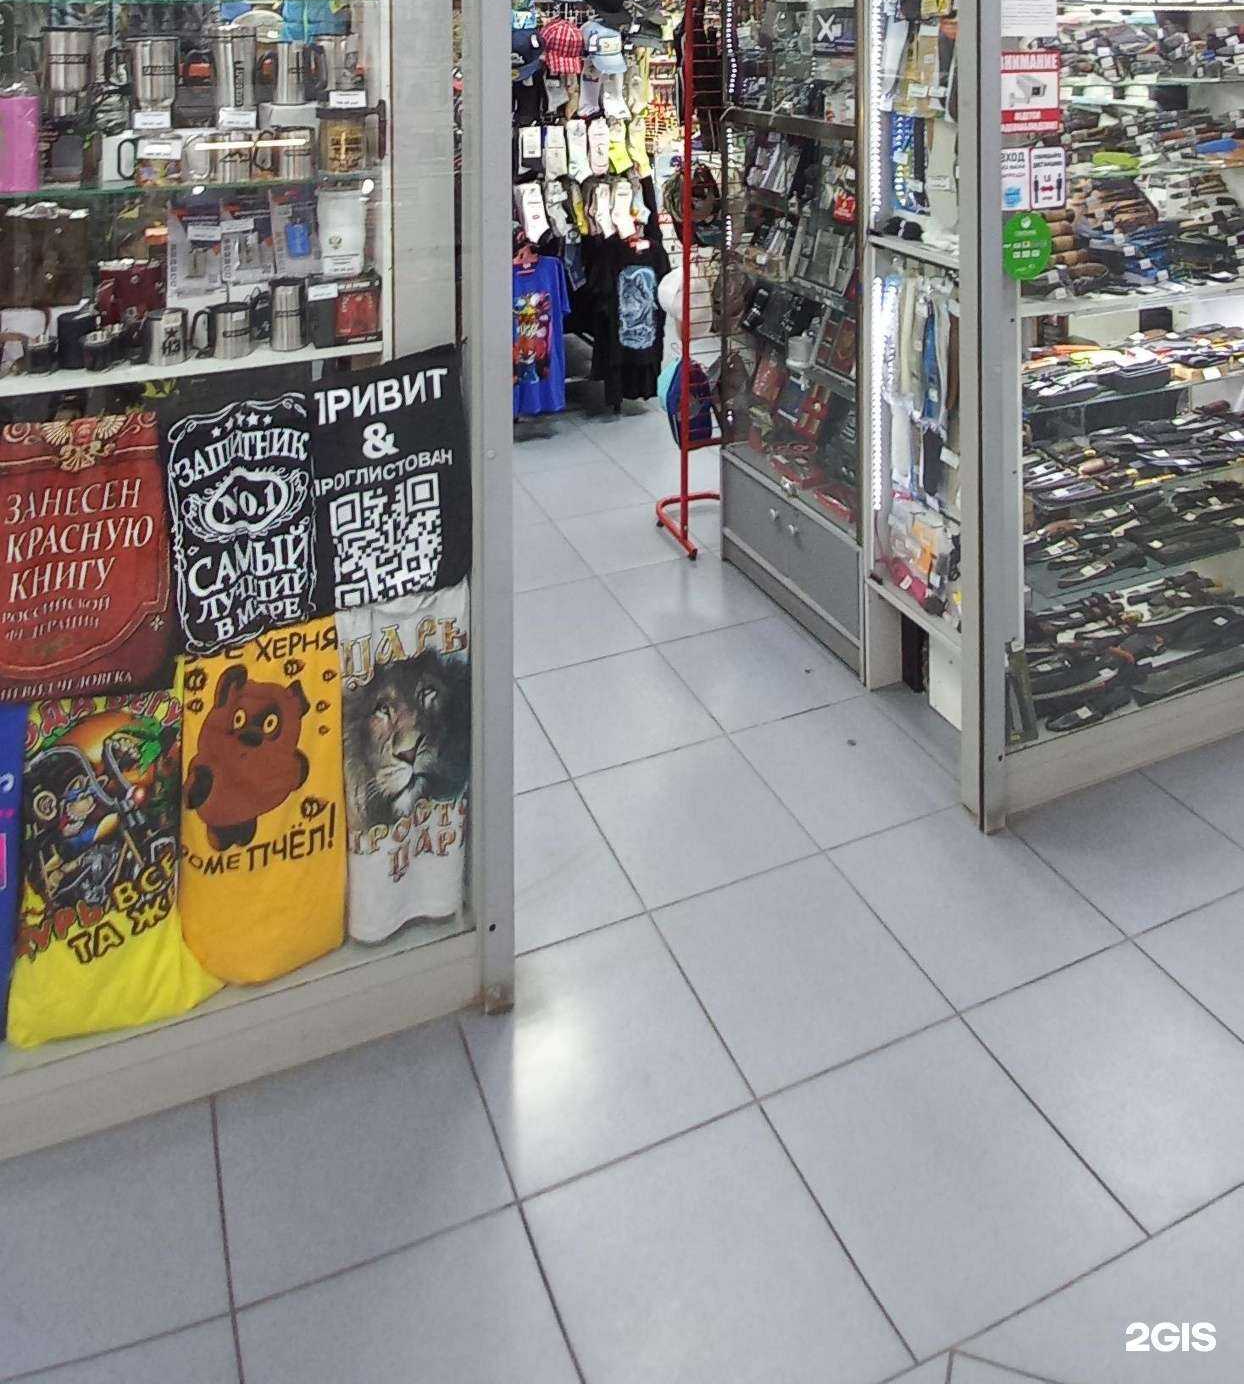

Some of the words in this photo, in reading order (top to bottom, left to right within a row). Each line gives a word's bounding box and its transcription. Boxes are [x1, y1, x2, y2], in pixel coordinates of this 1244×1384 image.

[362, 422, 400, 459] &
[5, 478, 142, 524] ЗАНЕСЕН
[6, 515, 154, 564] КРАСНУЮ
[188, 524, 308, 597] САМЫЙ
[9, 557, 116, 603] КНИГУ
[215, 617, 235, 641] В
[255, 625, 338, 662] ХЕРНЯ
[340, 615, 468, 691] ЦАРЬ
[246, 802, 335, 872] ПЧЁЛ!
[67, 920, 125, 964] ТА
